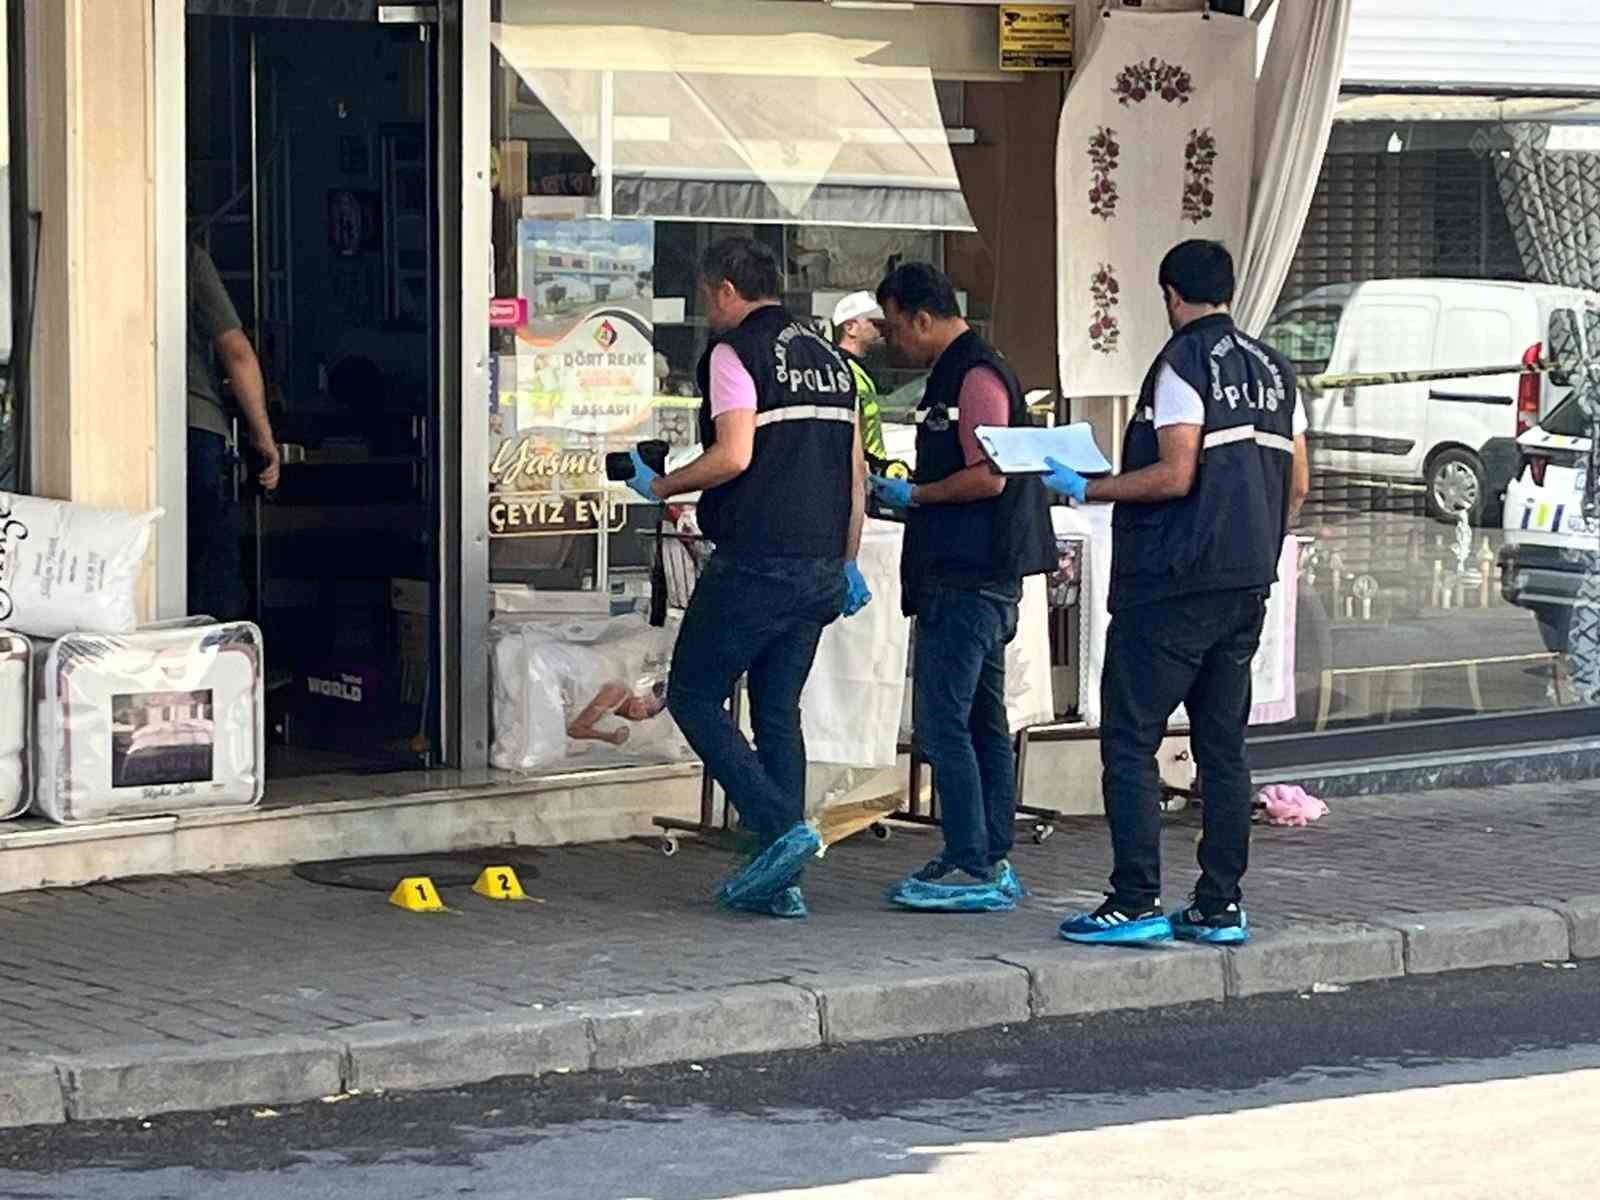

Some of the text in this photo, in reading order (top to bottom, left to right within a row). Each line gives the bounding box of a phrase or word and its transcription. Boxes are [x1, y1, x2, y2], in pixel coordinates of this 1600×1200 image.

[563, 350, 647, 367] DÖRT RENK
[489, 438, 606, 485] Yasmi
[307, 676, 362, 702] WORLD
[498, 874, 511, 891] 2
[416, 884, 427, 901] 1
